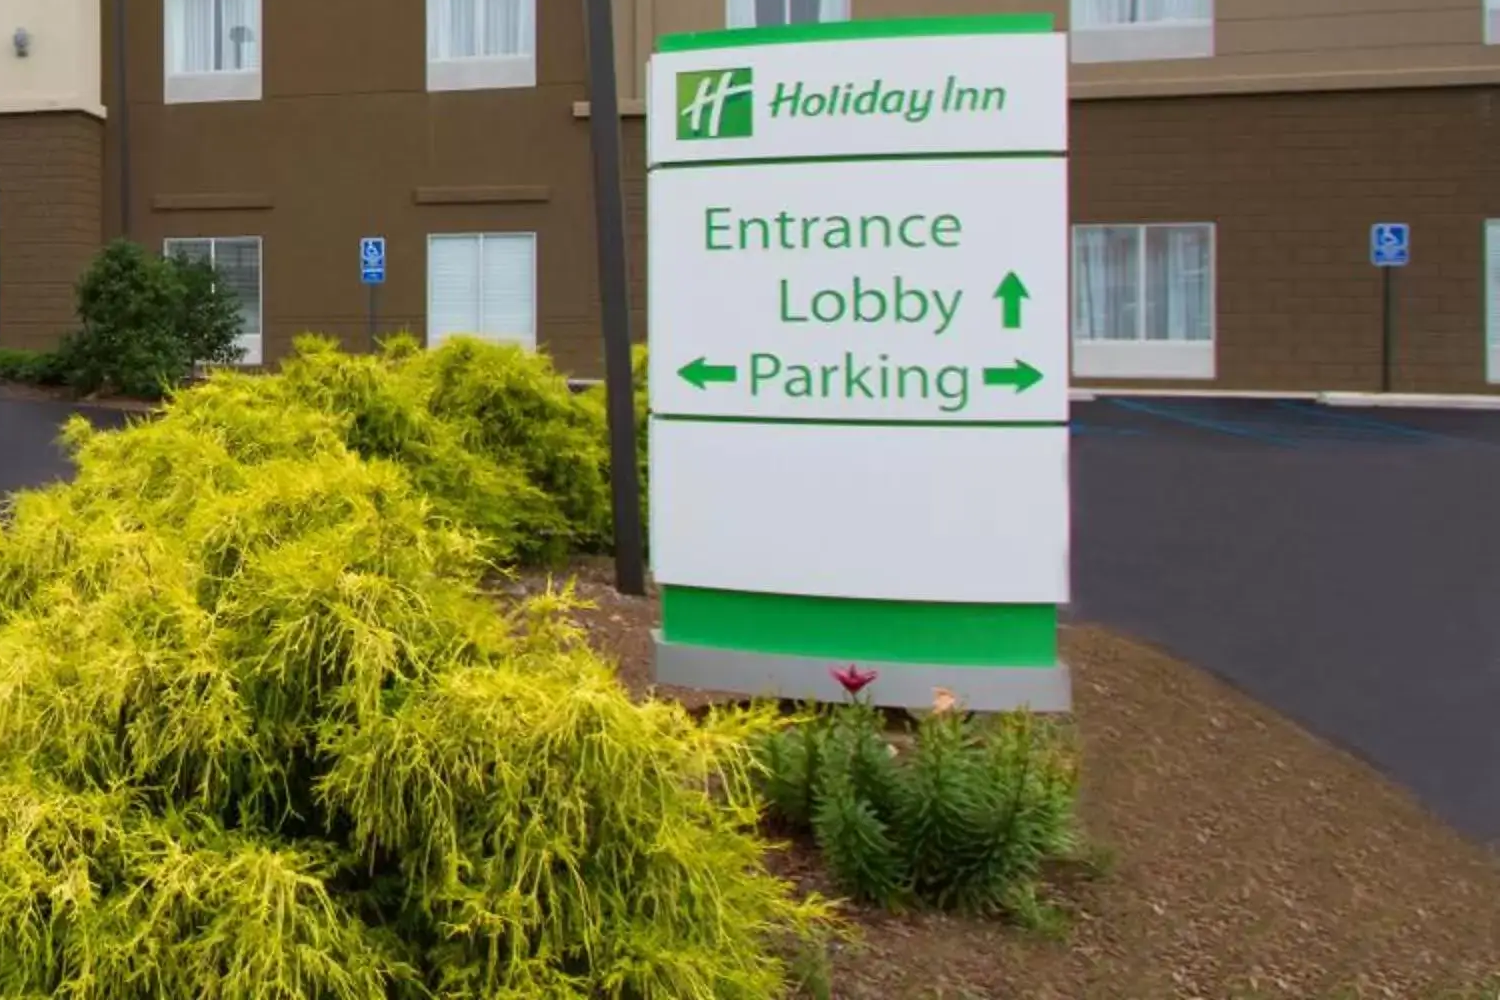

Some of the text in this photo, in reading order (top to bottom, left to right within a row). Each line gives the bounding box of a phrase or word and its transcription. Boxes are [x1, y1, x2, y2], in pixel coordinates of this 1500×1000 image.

[769, 76, 1007, 124] Holiday Inn
[704, 206, 963, 252] Entrance
[779, 276, 963, 336] Lobby
[748, 351, 971, 413] Parking
